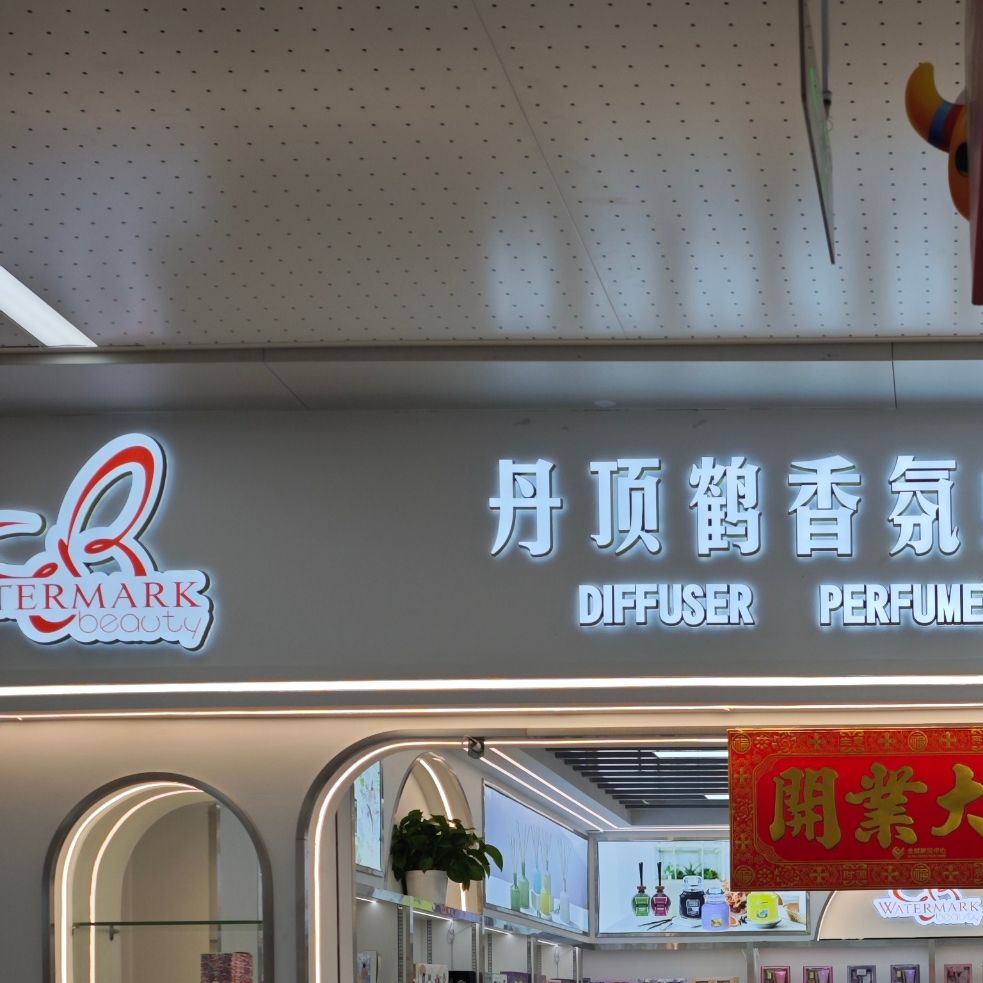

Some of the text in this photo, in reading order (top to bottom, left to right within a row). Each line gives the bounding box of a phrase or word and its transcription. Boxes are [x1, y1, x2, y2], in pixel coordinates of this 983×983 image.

[579, 584, 755, 627] DIFFUSER
[78, 610, 202, 639] beauty
[879, 901, 979, 914] WATERMARK
